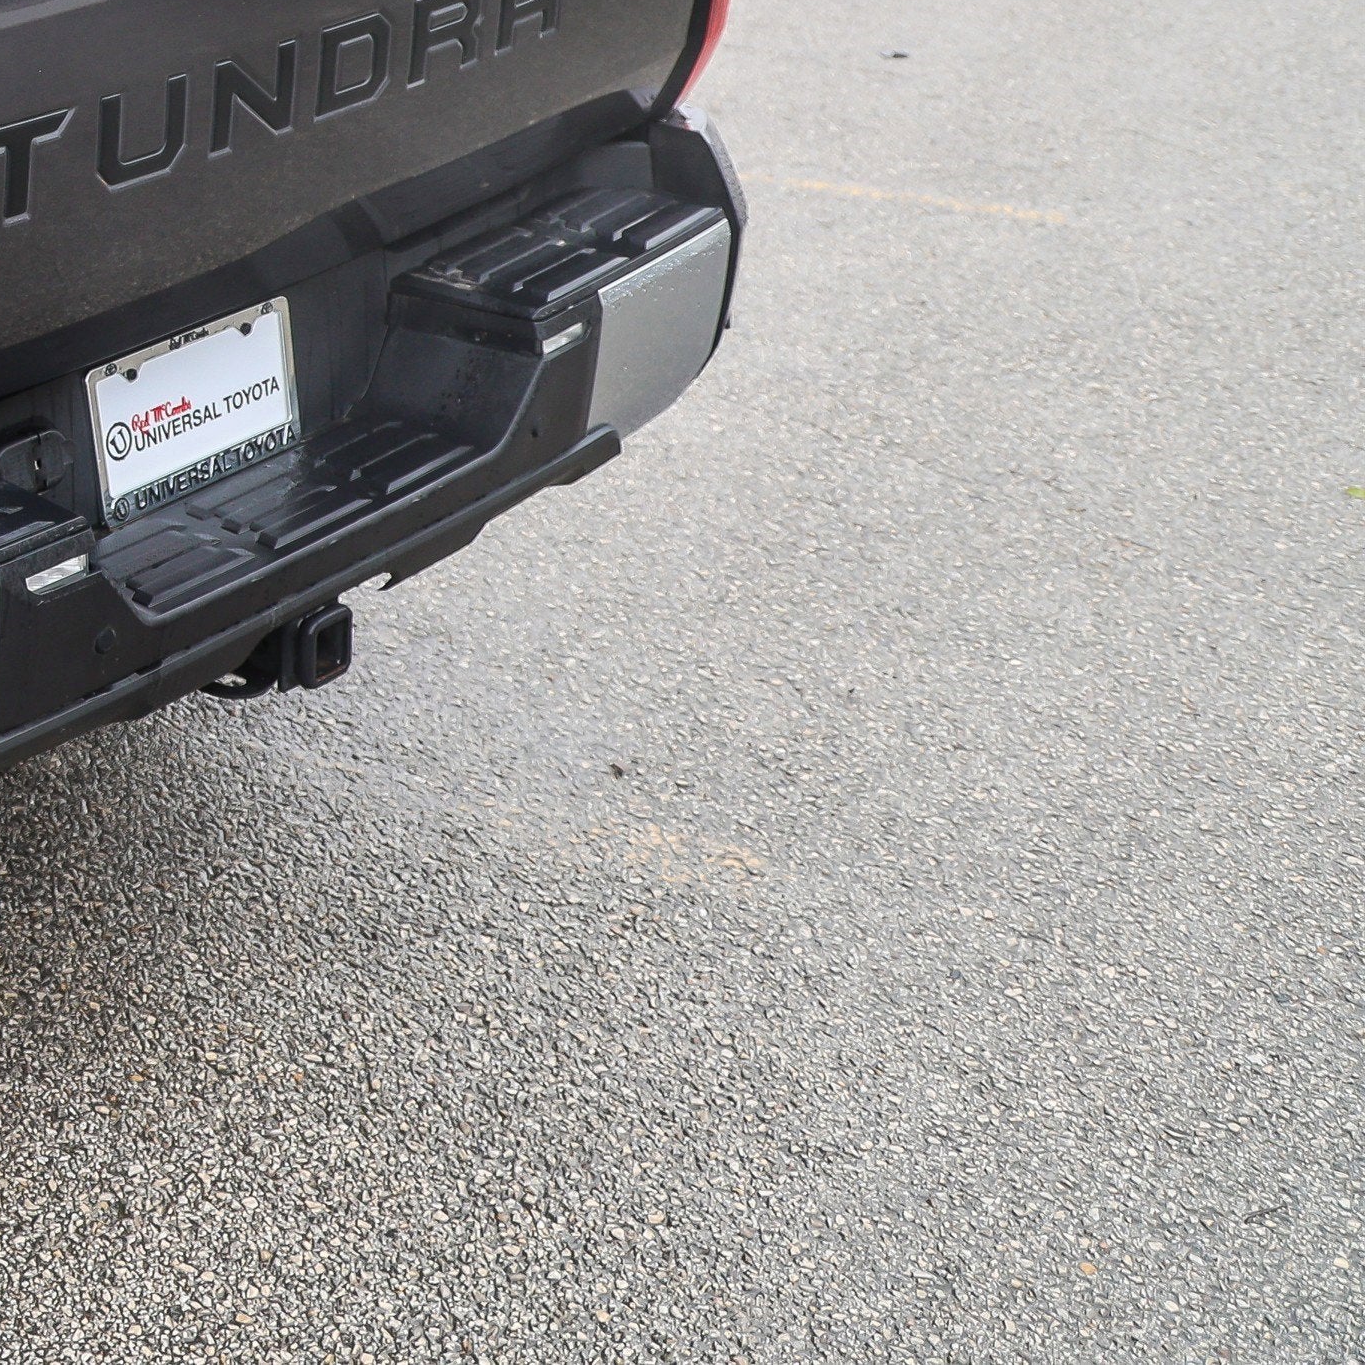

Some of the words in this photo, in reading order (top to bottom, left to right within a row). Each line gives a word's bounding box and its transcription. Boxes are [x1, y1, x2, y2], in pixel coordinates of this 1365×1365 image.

[131, 411, 151, 436] Red
[134, 402, 223, 452] UNIVERSAL
[222, 376, 280, 414] TOYOTA
[134, 451, 232, 511] UNIVERSAL
[231, 424, 297, 466] TOYOTA
